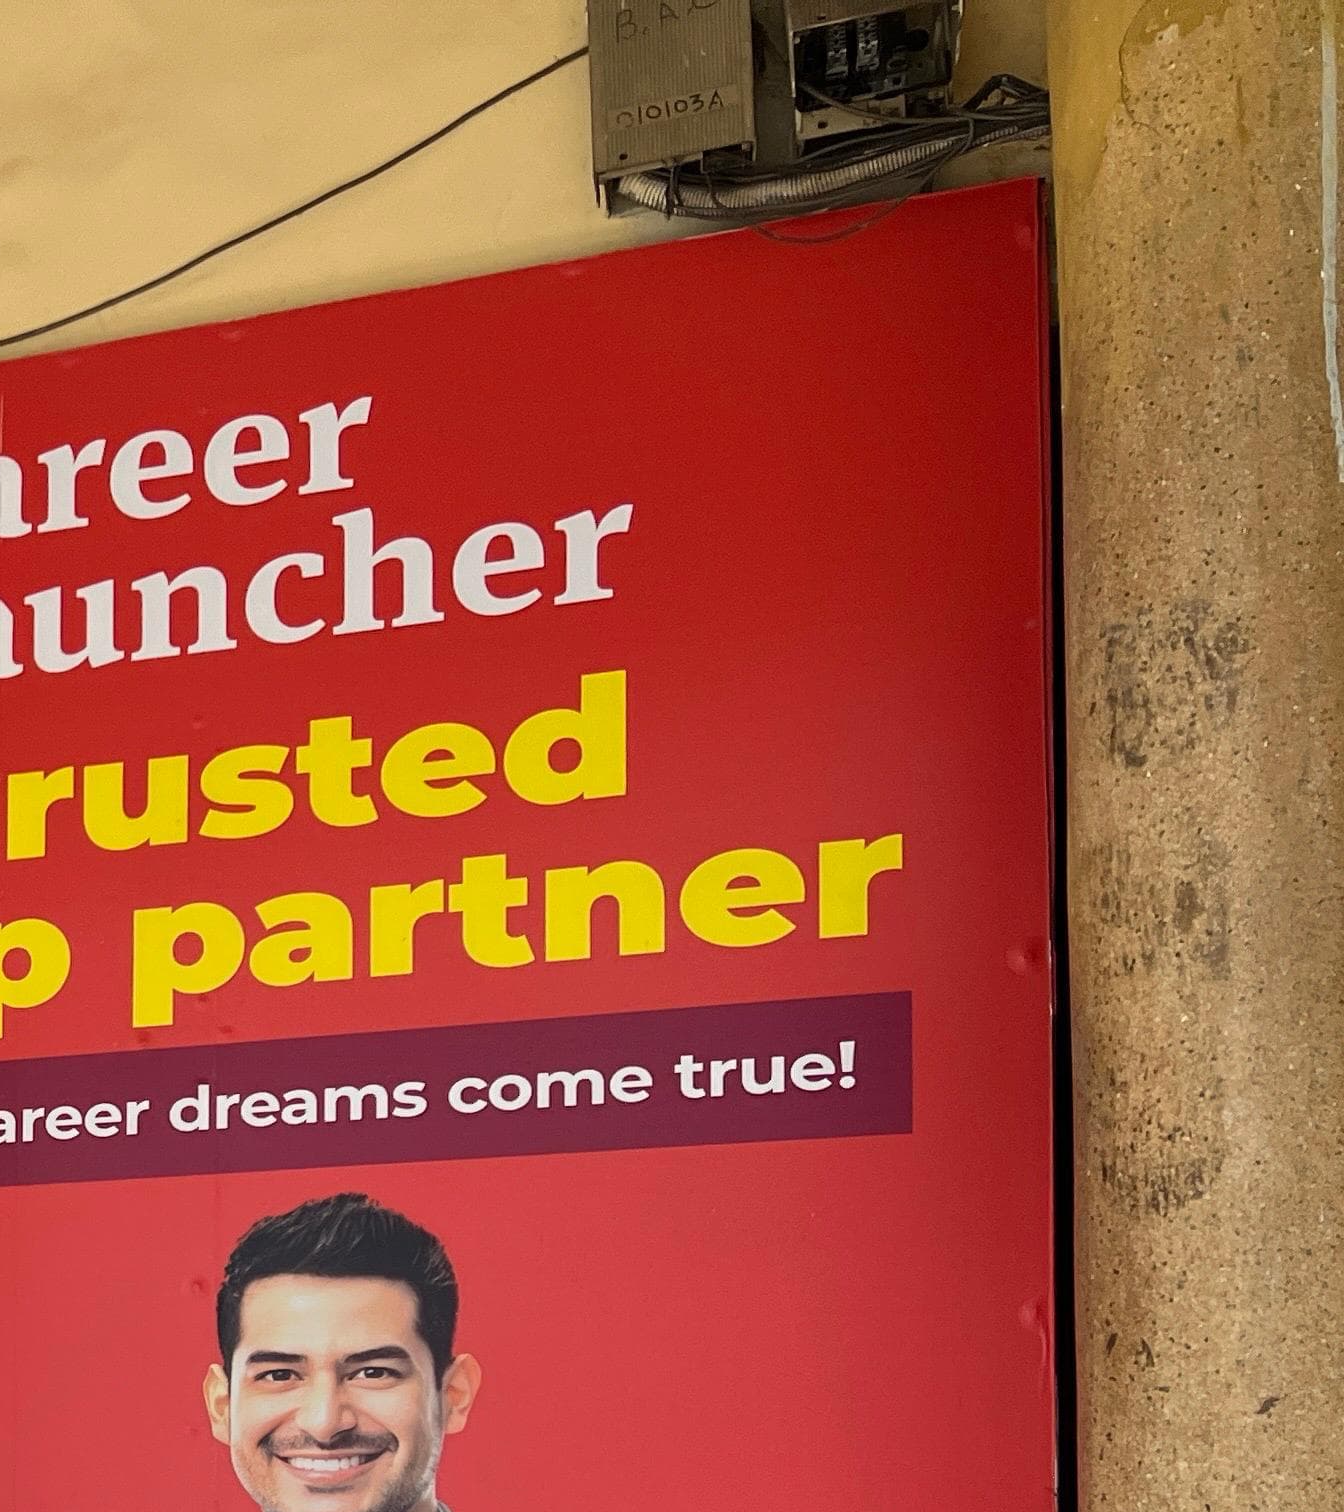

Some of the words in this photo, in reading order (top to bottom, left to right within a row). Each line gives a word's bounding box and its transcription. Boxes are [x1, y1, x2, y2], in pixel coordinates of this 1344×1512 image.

[132, 833, 903, 1028] partner
[169, 1081, 428, 1132] dreams
[447, 1065, 653, 1114] come
[674, 1040, 856, 1099] true!
